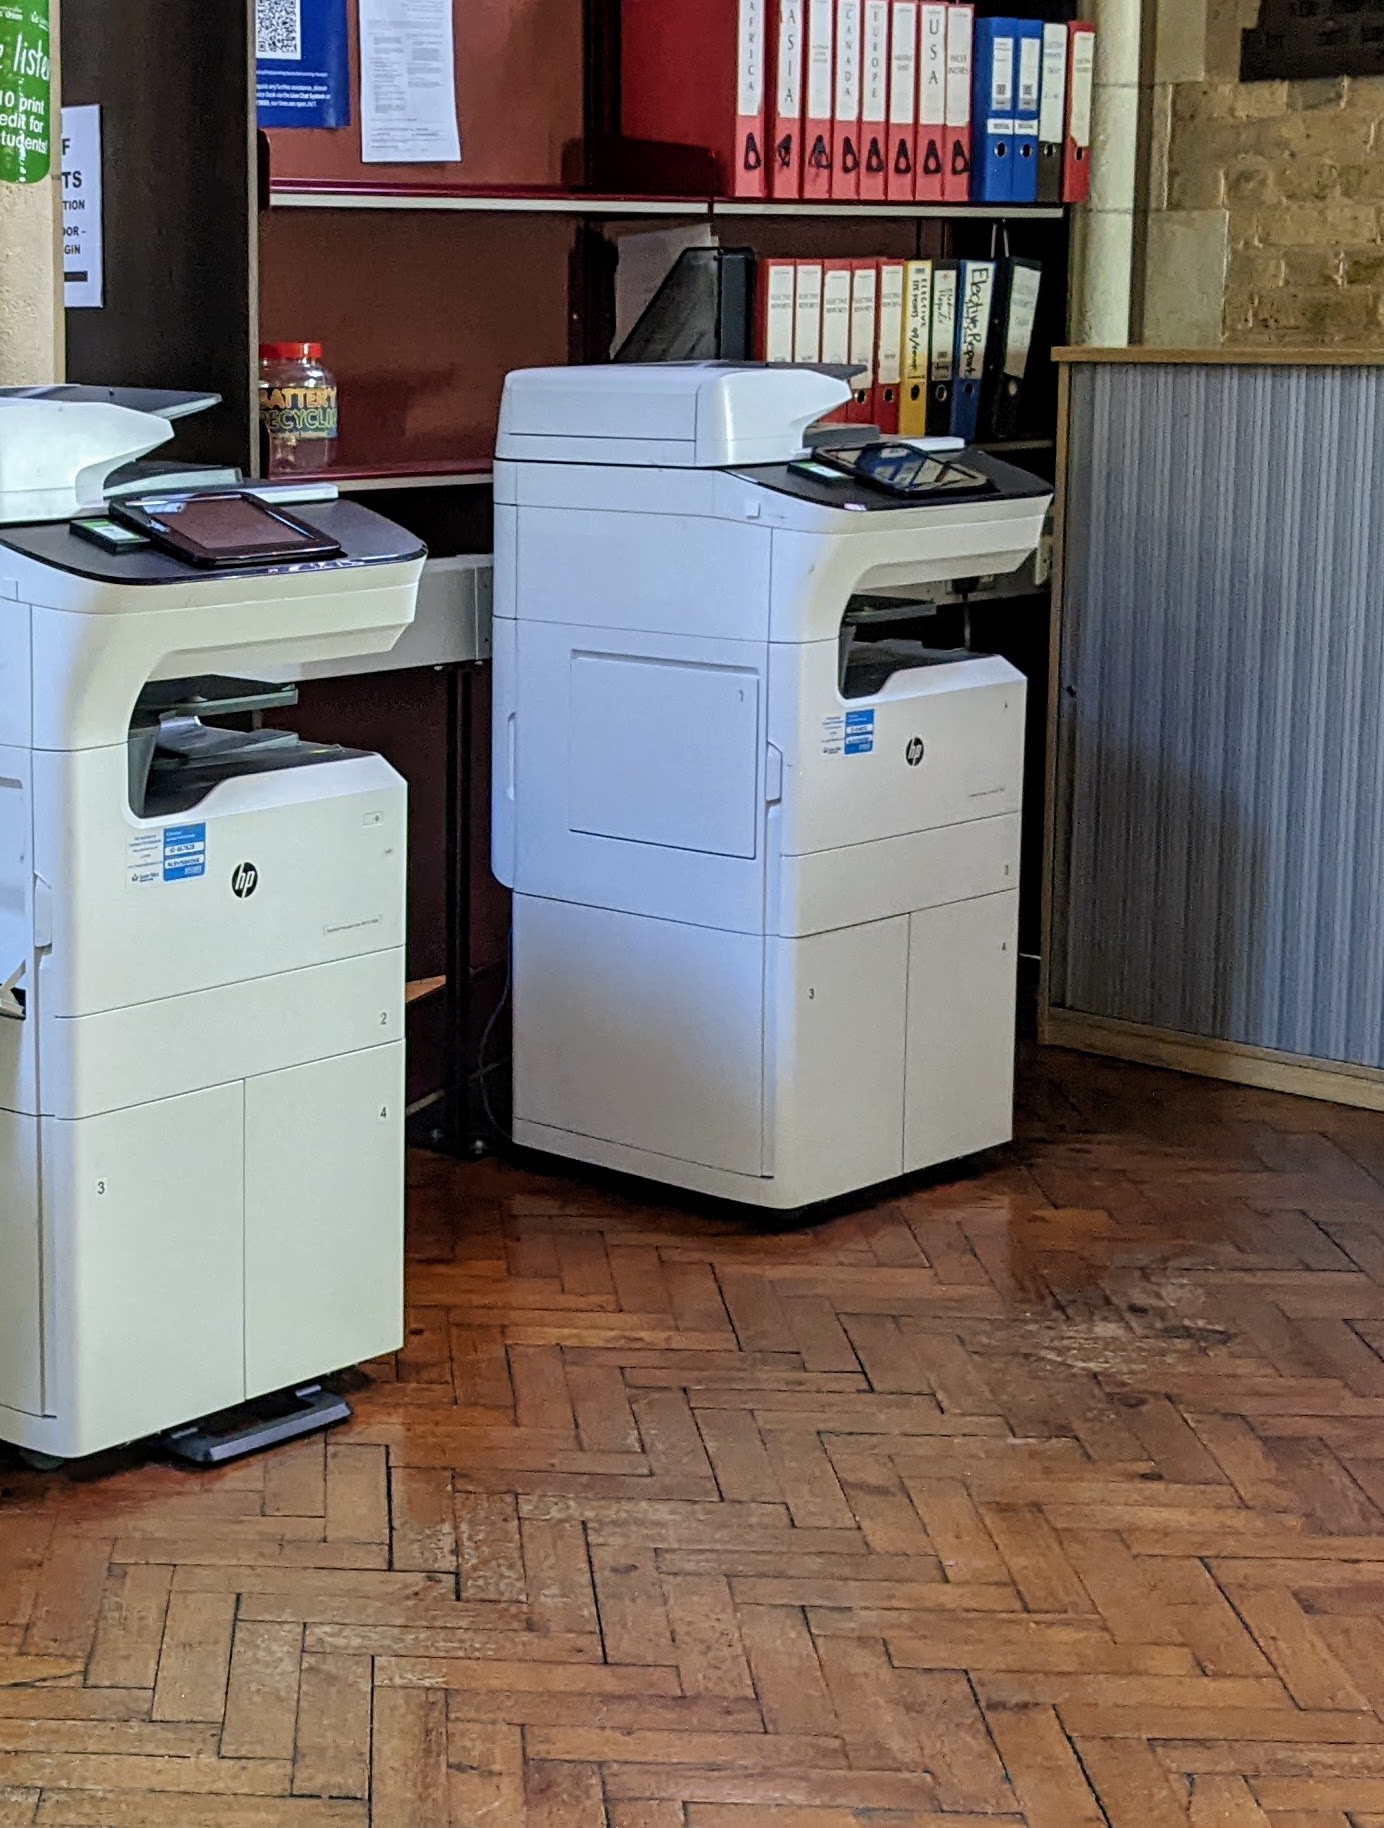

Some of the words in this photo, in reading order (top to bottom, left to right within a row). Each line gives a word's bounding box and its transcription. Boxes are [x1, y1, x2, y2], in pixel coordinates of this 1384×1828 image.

[747, 1, 756, 92] AFRICA
[844, 9, 853, 97] CANADA
[928, 18, 939, 85] USA
[13, 32, 50, 81] liste
[784, 8, 796, 104] ASIA
[18, 97, 45, 115] print
[29, 115, 44, 133] for
[62, 138, 71, 156] F
[62, 170, 83, 189] TS
[62, 200, 85, 210] TION
[64, 244, 81, 254] GIN
[907, 737, 923, 766] hp
[234, 862, 256, 898] hp
[809, 988, 815, 1000] 3
[380, 1012, 387, 1025] 2
[380, 1106, 387, 1119] 4
[97, 1181, 105, 1195] 3
